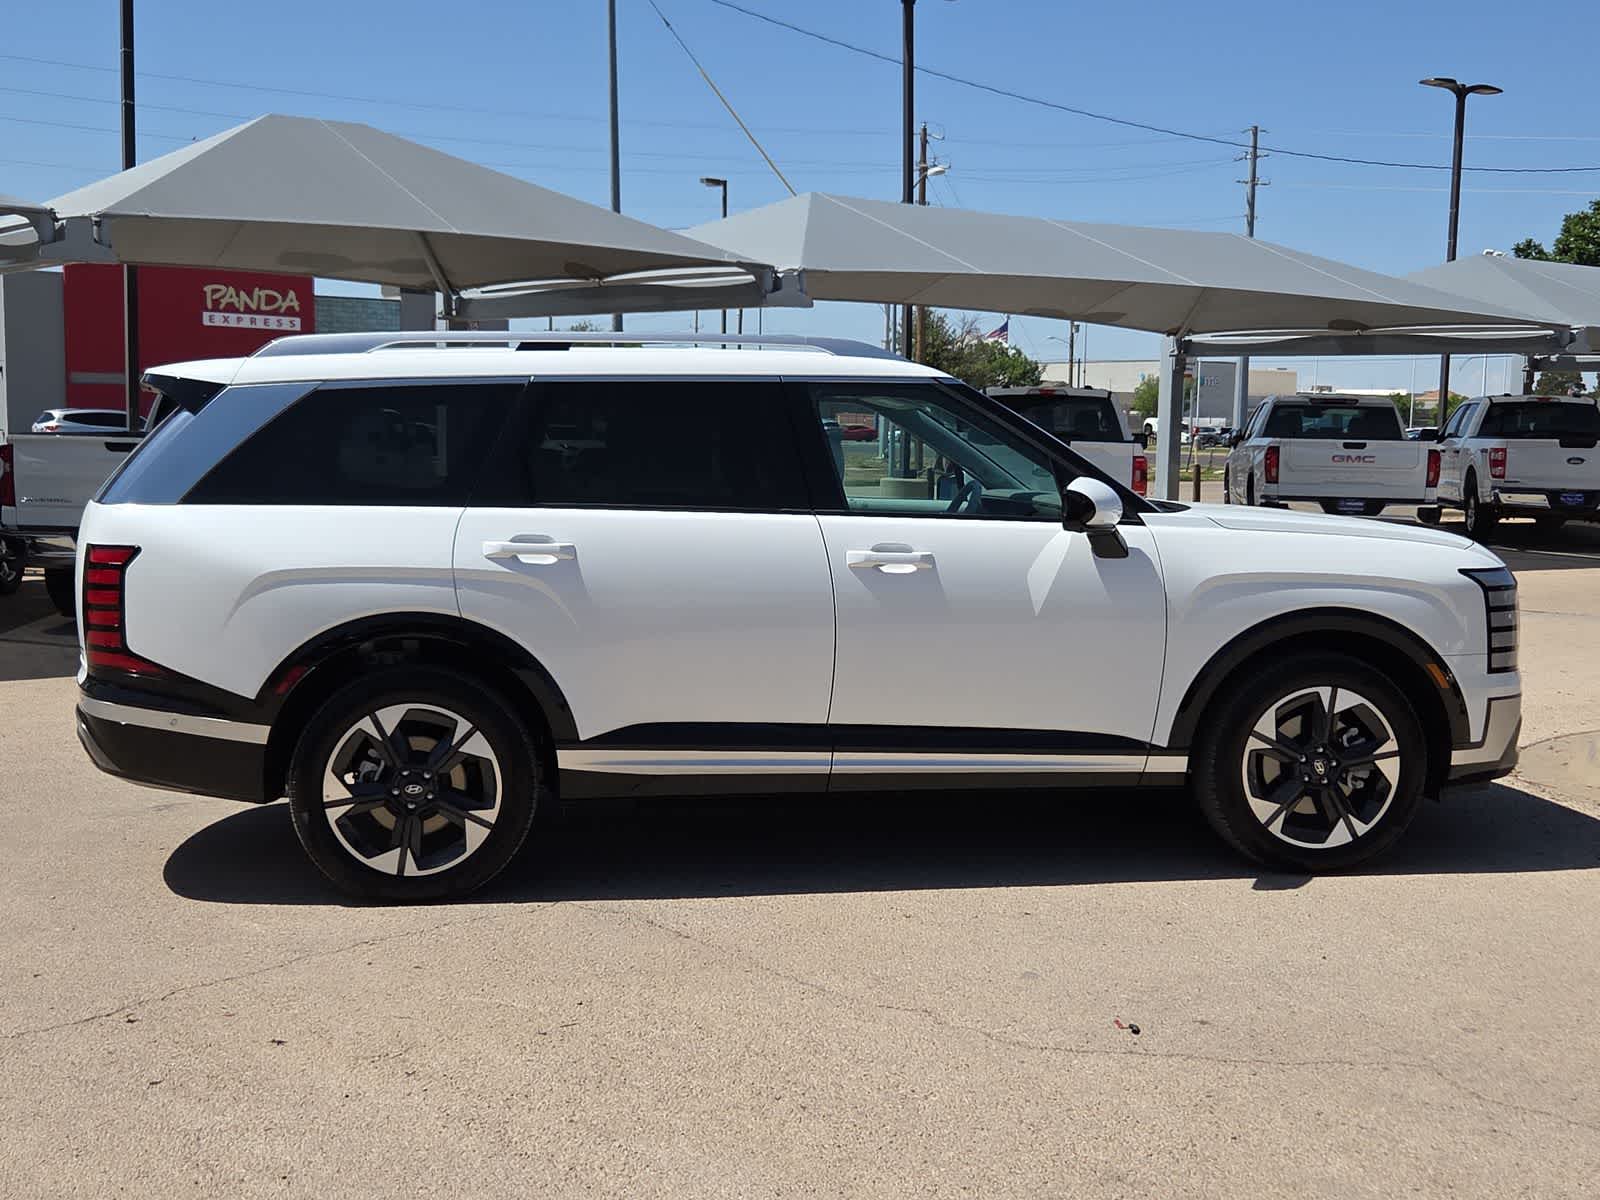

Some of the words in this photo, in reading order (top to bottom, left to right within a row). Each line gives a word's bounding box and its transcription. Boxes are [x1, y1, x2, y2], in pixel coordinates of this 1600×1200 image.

[203, 284, 300, 313] PANDA
[208, 314, 297, 328] EXPRESS
[1331, 454, 1376, 464] GMC
